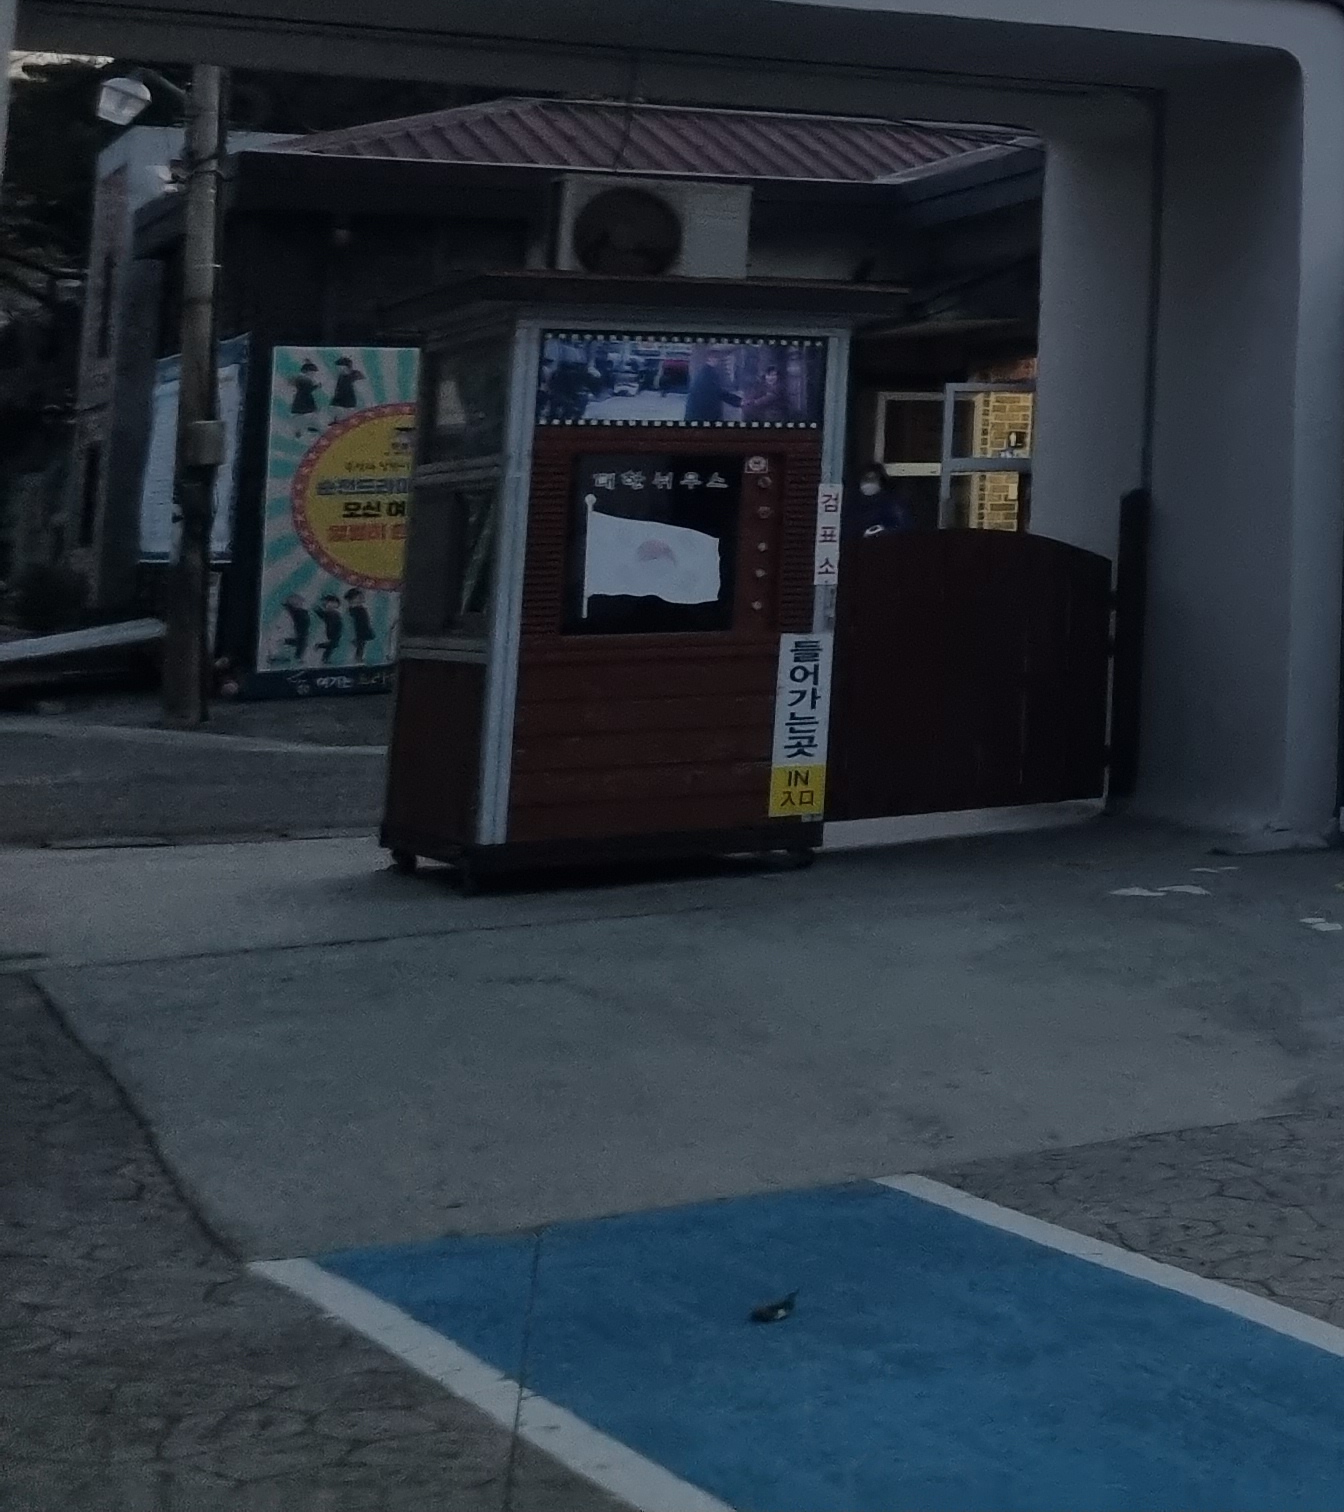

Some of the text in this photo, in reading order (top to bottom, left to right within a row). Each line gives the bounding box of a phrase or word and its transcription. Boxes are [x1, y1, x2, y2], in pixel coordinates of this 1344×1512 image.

[818, 492, 840, 578] 검표소
[784, 639, 823, 759] 들어가는곳
[780, 790, 815, 807] 入口
[787, 770, 810, 787] IN
